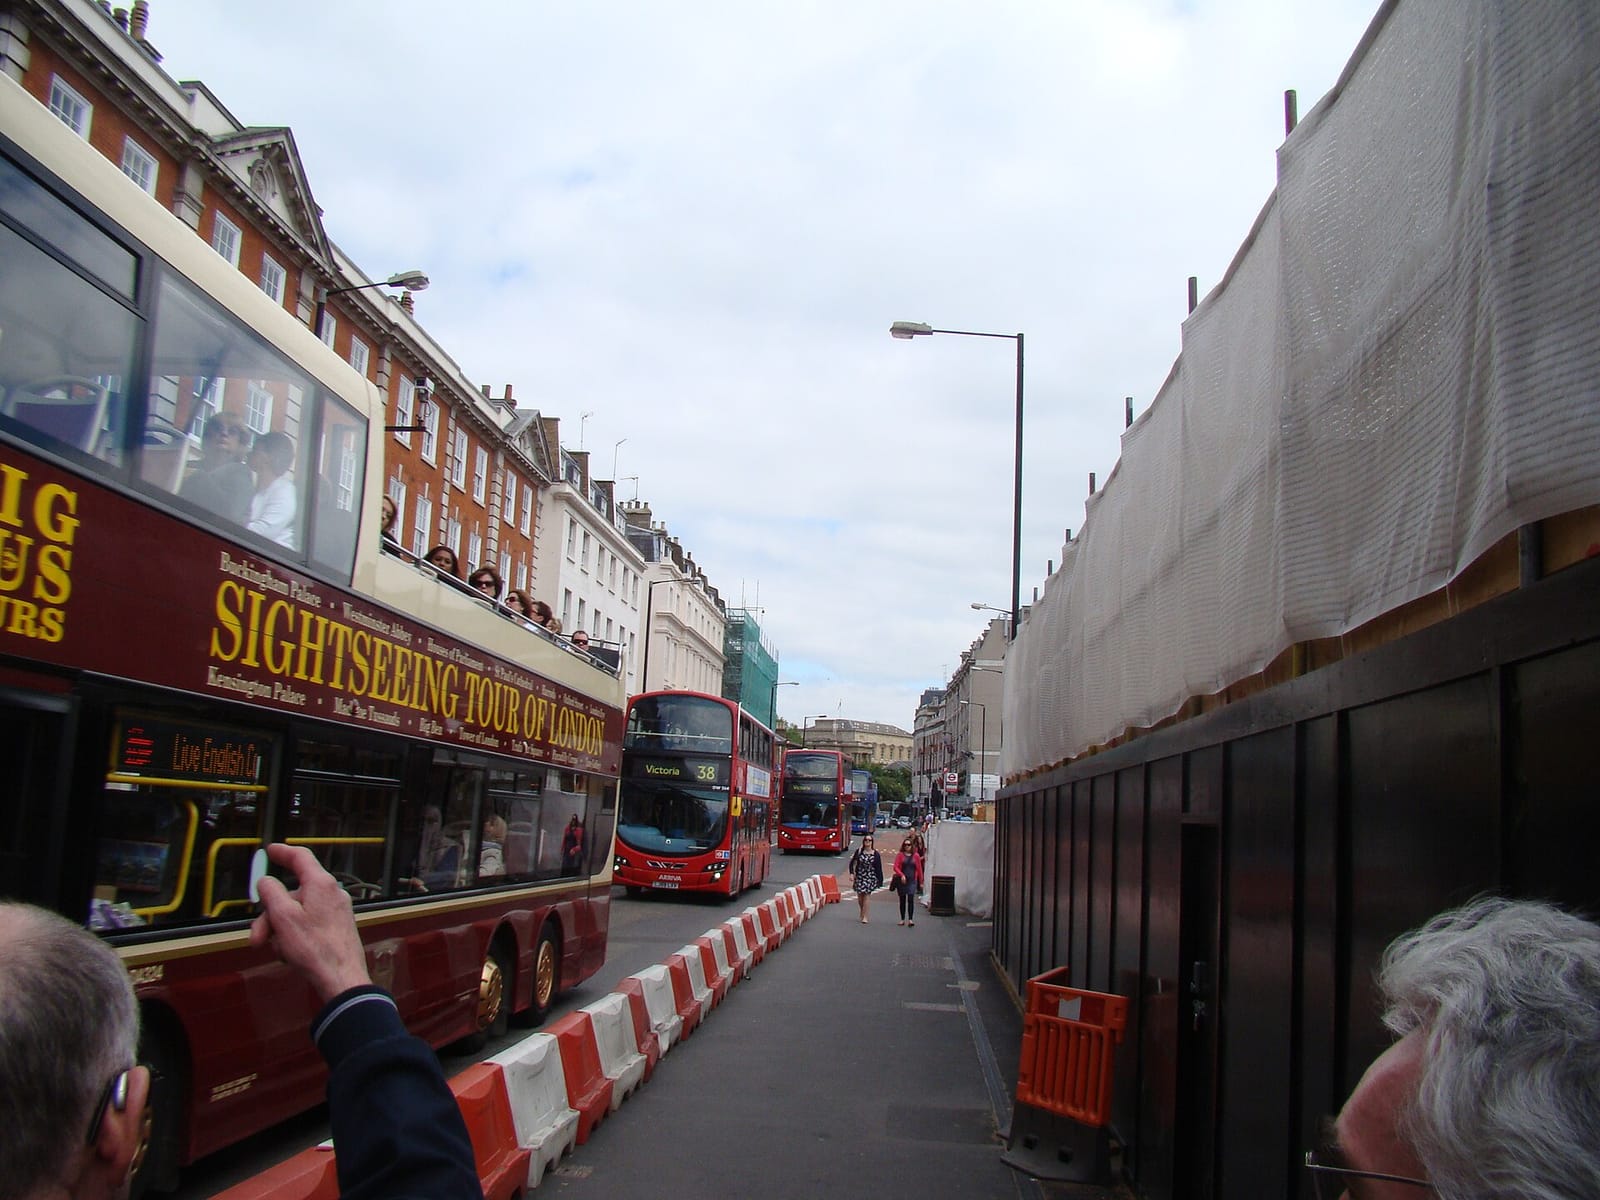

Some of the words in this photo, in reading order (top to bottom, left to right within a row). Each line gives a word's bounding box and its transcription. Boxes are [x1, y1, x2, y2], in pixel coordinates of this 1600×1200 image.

[220, 551, 289, 591] Buckingham
[290, 580, 321, 608] Palace
[342, 602, 390, 634] Westminster
[207, 665, 271, 699] Kensington
[272, 682, 306, 706] Palace
[210, 580, 460, 720] SIGHTSEEING
[464, 671, 520, 735] TOUR
[523, 693, 548, 742] OF
[548, 703, 606, 757] LONDON
[419, 718, 431, 736] Big
[430, 720, 443, 736] Ben
[172, 733, 201, 772] Live
[202, 737, 245, 776] English
[645, 764, 680, 776] Victoria
[697, 765, 716, 780] 38
[658, 874, 682, 882] ARRIVA
